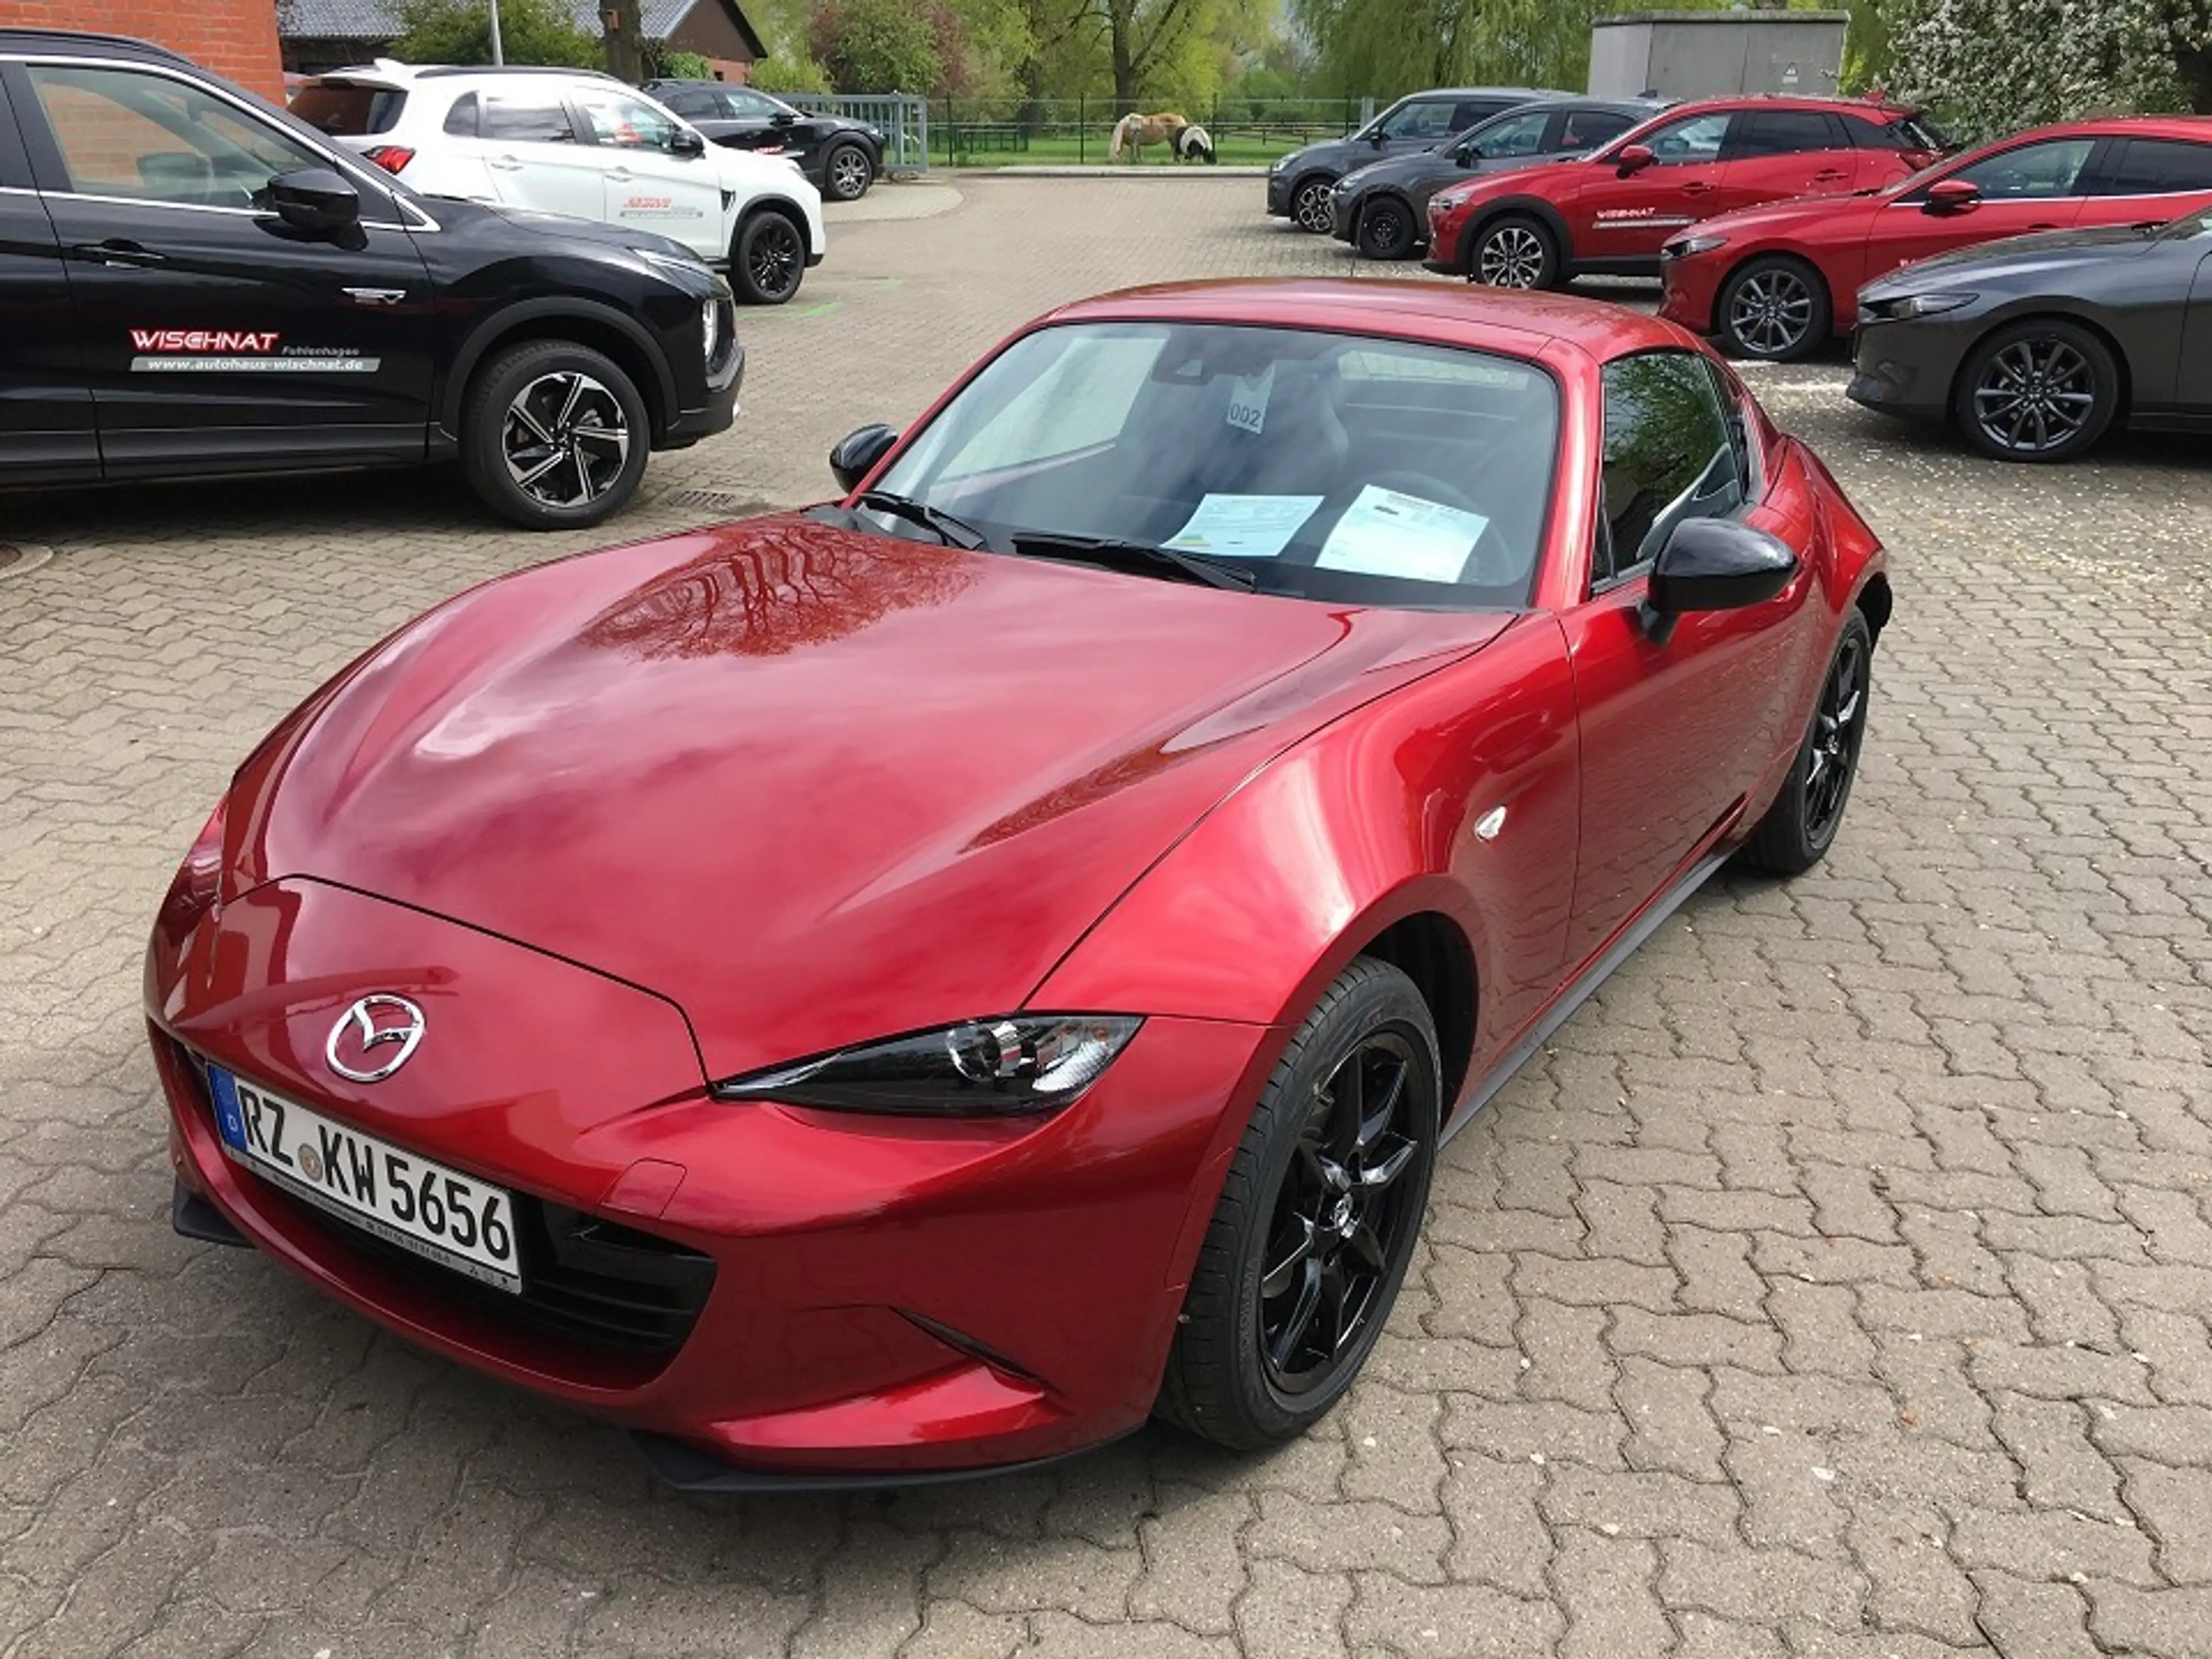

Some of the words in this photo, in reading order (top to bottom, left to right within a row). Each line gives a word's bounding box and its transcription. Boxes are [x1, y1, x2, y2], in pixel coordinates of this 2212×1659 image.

[130, 329, 279, 351] WISCHNAT
[147, 358, 364, 371] www.autohaus-wischnat.de
[1230, 404, 1262, 427] 002
[238, 1085, 293, 1167] RZ
[319, 1124, 376, 1207] KW
[385, 1154, 510, 1261] 5656
